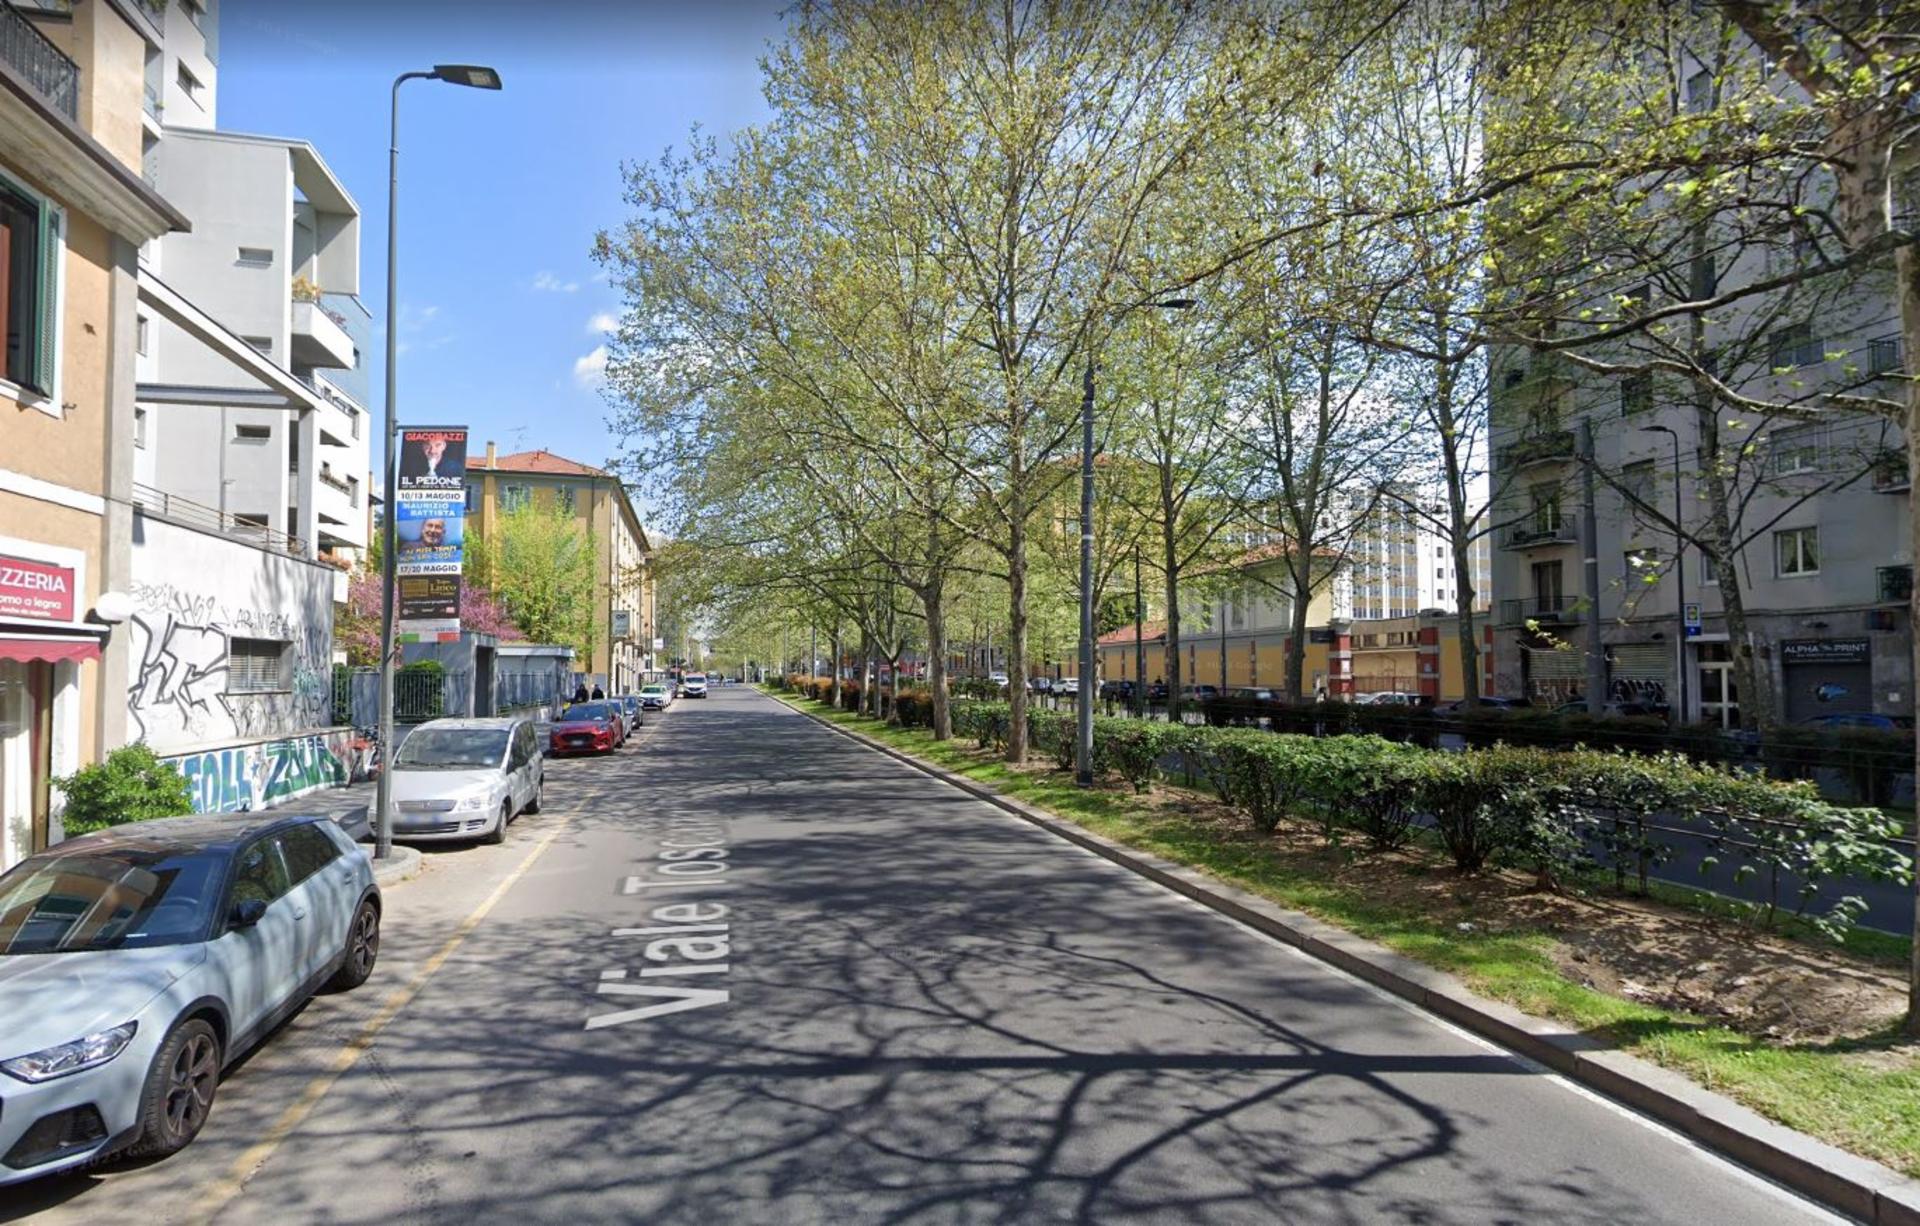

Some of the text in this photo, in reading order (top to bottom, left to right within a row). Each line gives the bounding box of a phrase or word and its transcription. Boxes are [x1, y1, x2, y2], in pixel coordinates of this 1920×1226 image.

[402, 476, 461, 485] IL PEDONE
[401, 492, 461, 500] 10/13 MAGGIO
[401, 564, 458, 573] 17/20 MAGGIO
[34, 596, 62, 610] legna
[1784, 642, 1868, 654] ALPHA PRINT
